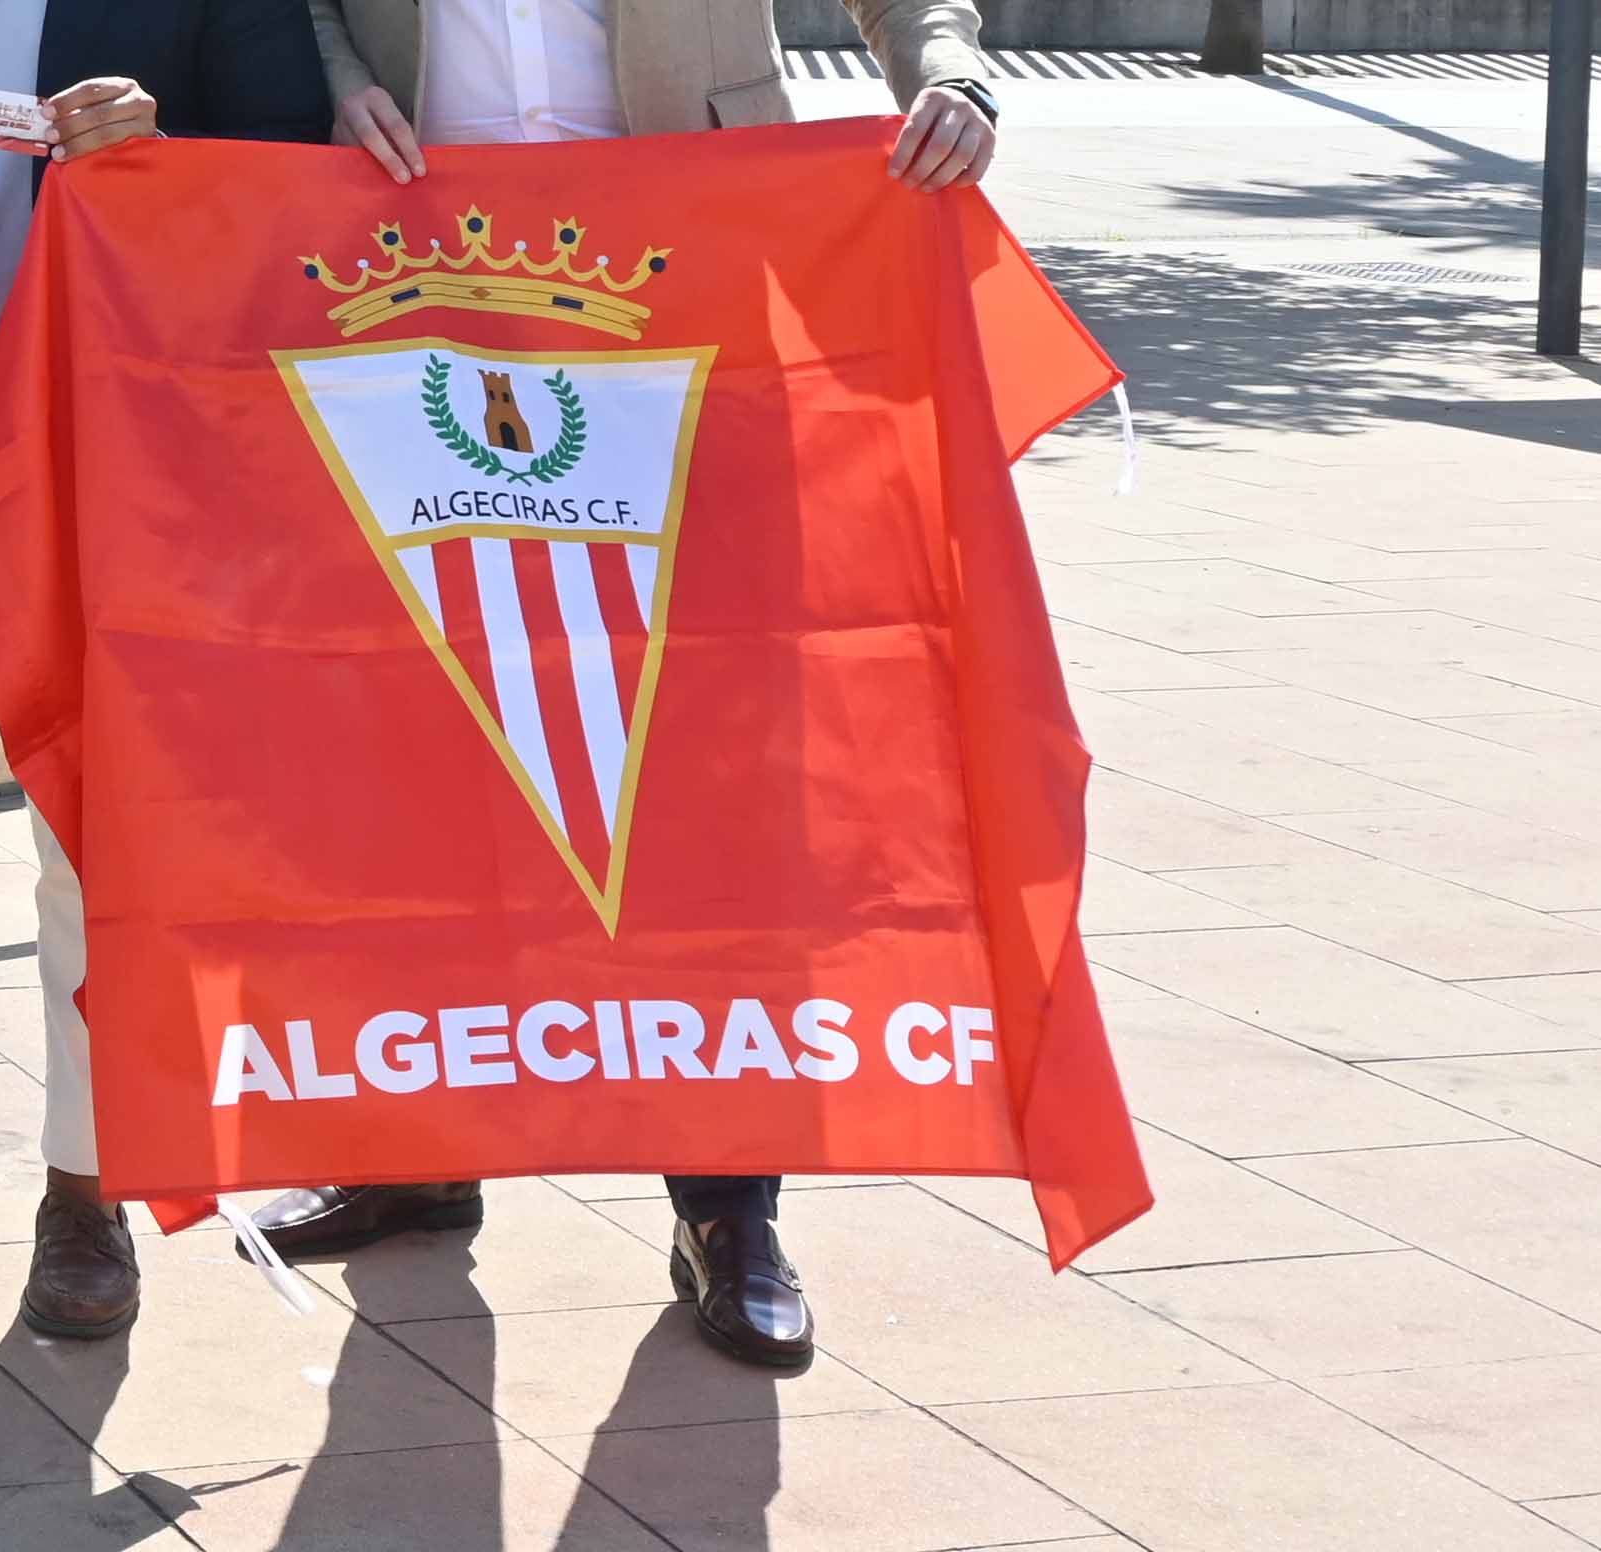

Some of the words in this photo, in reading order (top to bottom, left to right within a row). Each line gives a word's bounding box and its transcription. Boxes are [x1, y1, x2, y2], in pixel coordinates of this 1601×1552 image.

[410, 489, 580, 526] ALGECIRAS
[586, 498, 639, 526] C.F.
[210, 997, 861, 1108] ALGECIRAS
[883, 1000, 996, 1087] CF
